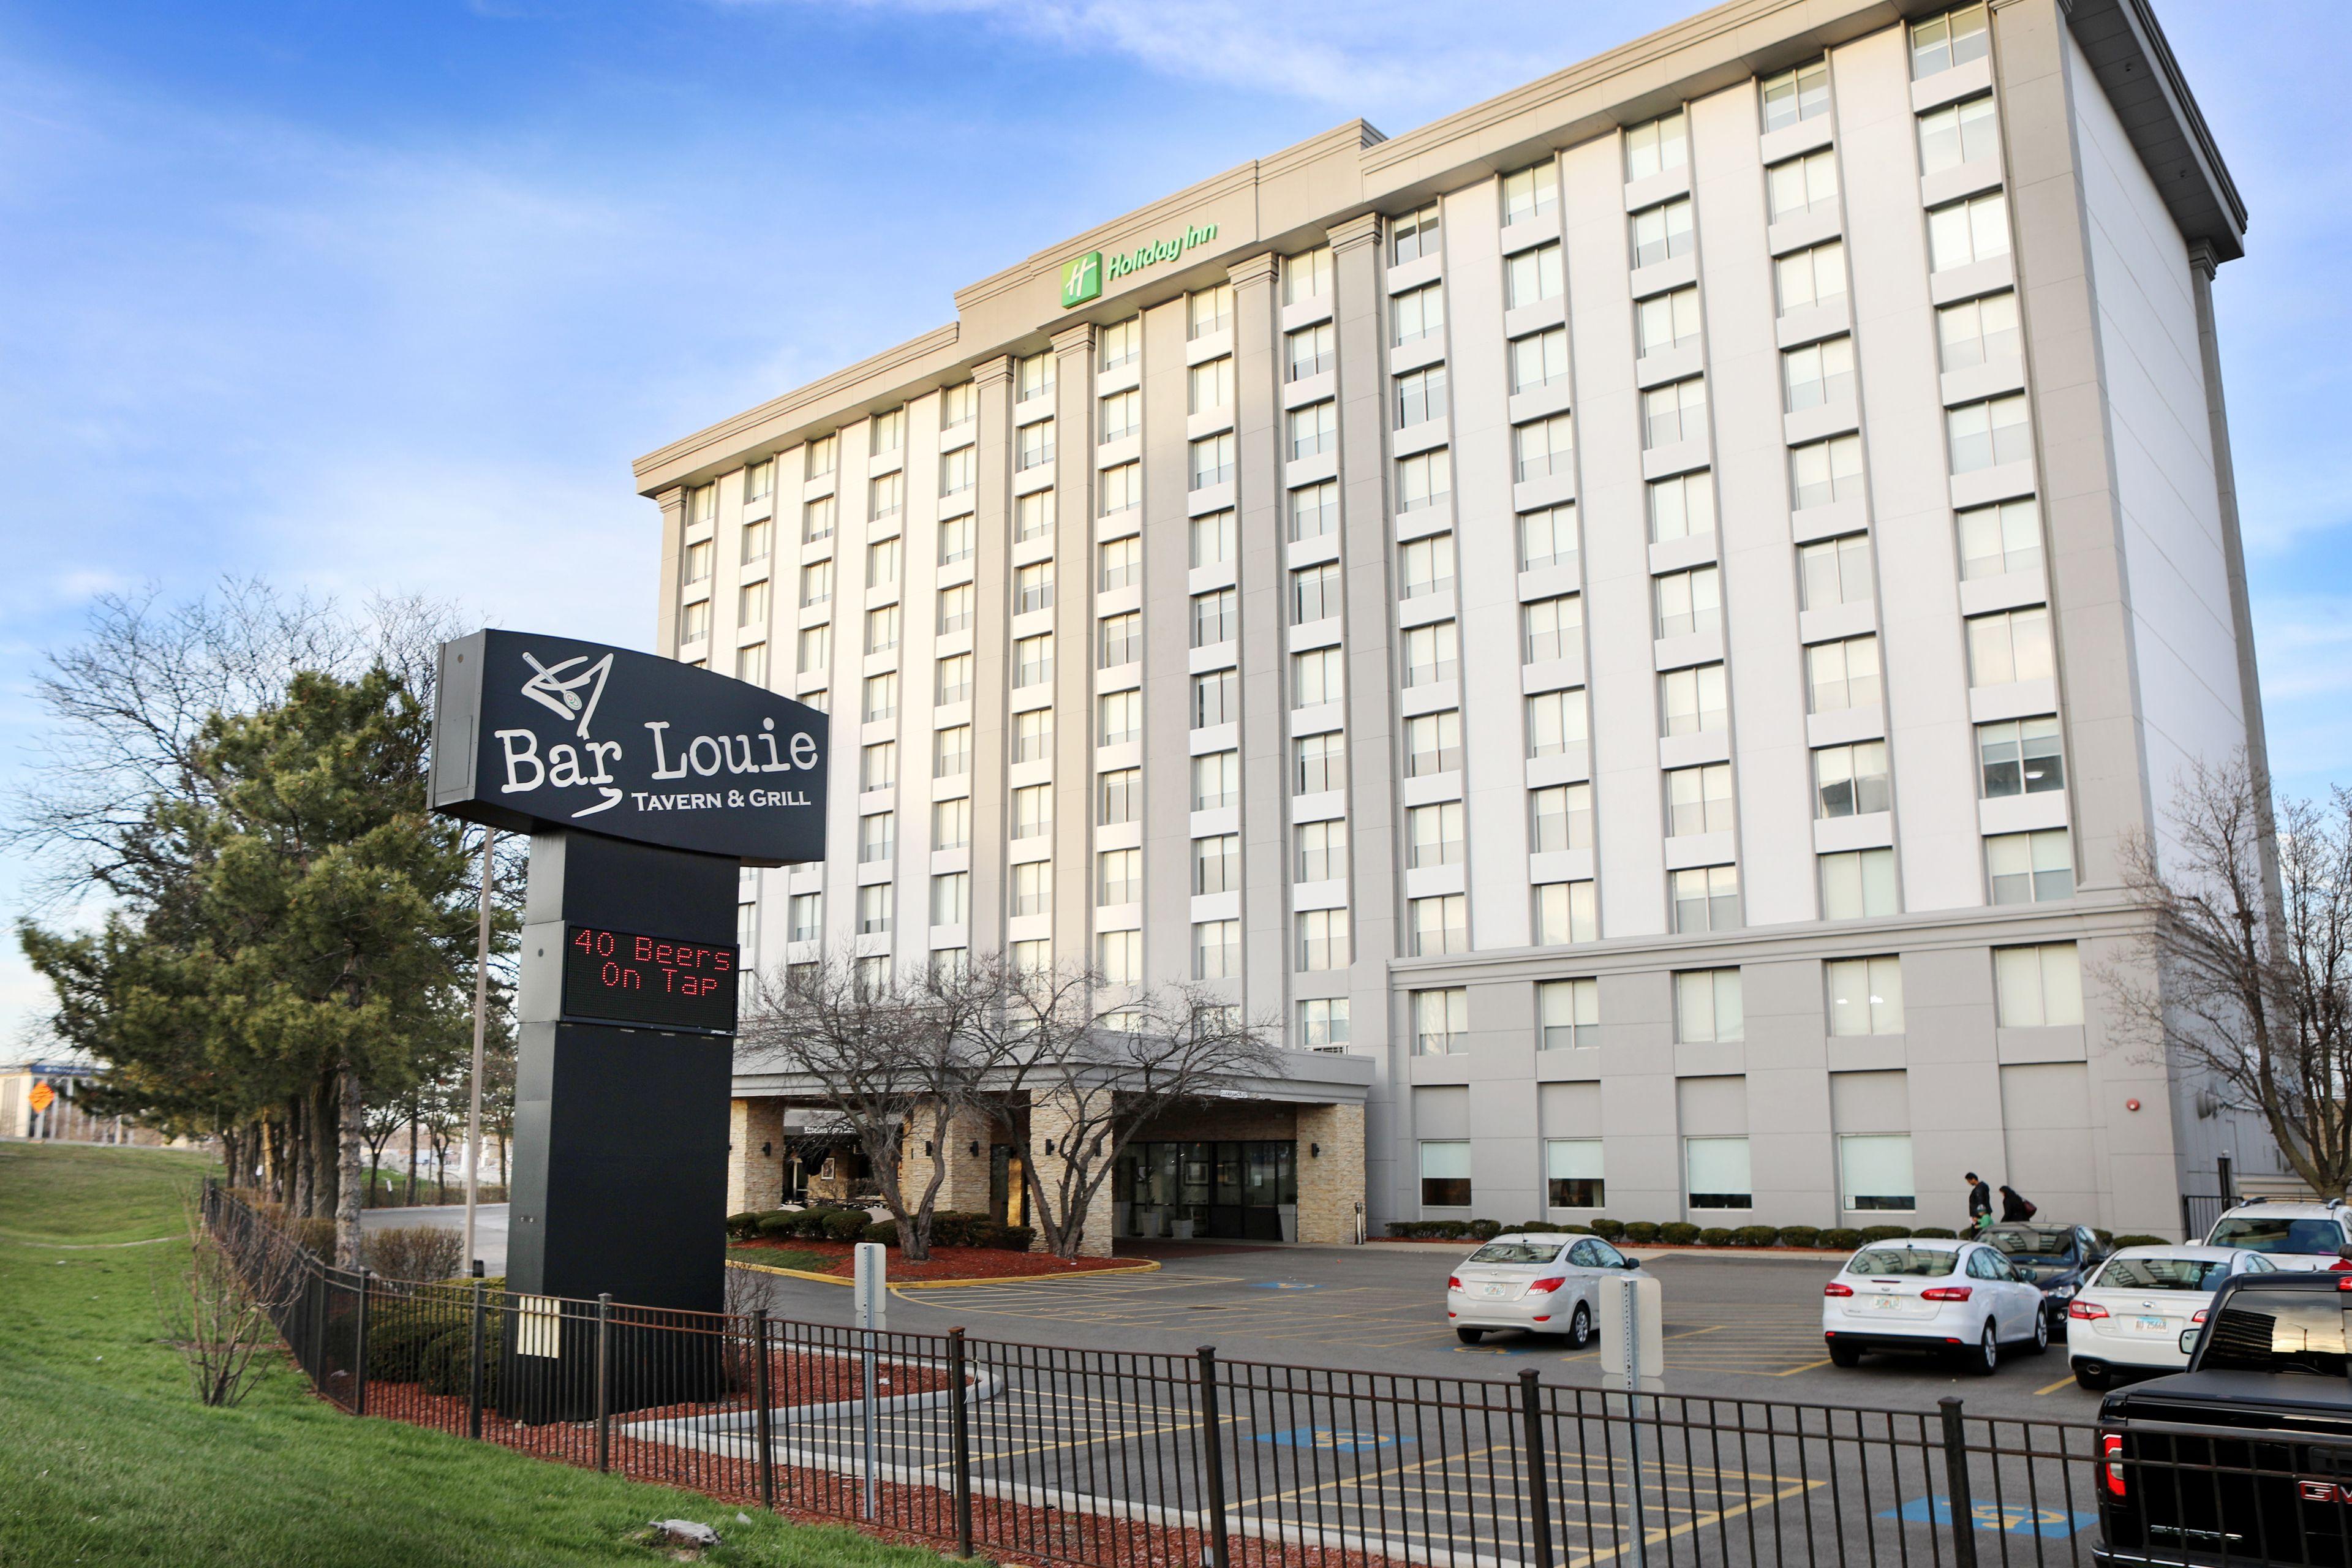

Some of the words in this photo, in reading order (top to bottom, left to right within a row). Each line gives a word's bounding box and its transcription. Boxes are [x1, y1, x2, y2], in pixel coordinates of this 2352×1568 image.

[1106, 237, 1183, 281] Holiday
[1185, 224, 1218, 250] Inn
[495, 728, 623, 794] Bar
[644, 717, 818, 780] Louie
[631, 791, 723, 812] TAVERN
[728, 790, 745, 808] &
[749, 789, 812, 808] GRILL
[575, 930, 615, 957] 40
[635, 937, 730, 971] Beers
[602, 962, 641, 989] On
[662, 968, 717, 997] Tap
